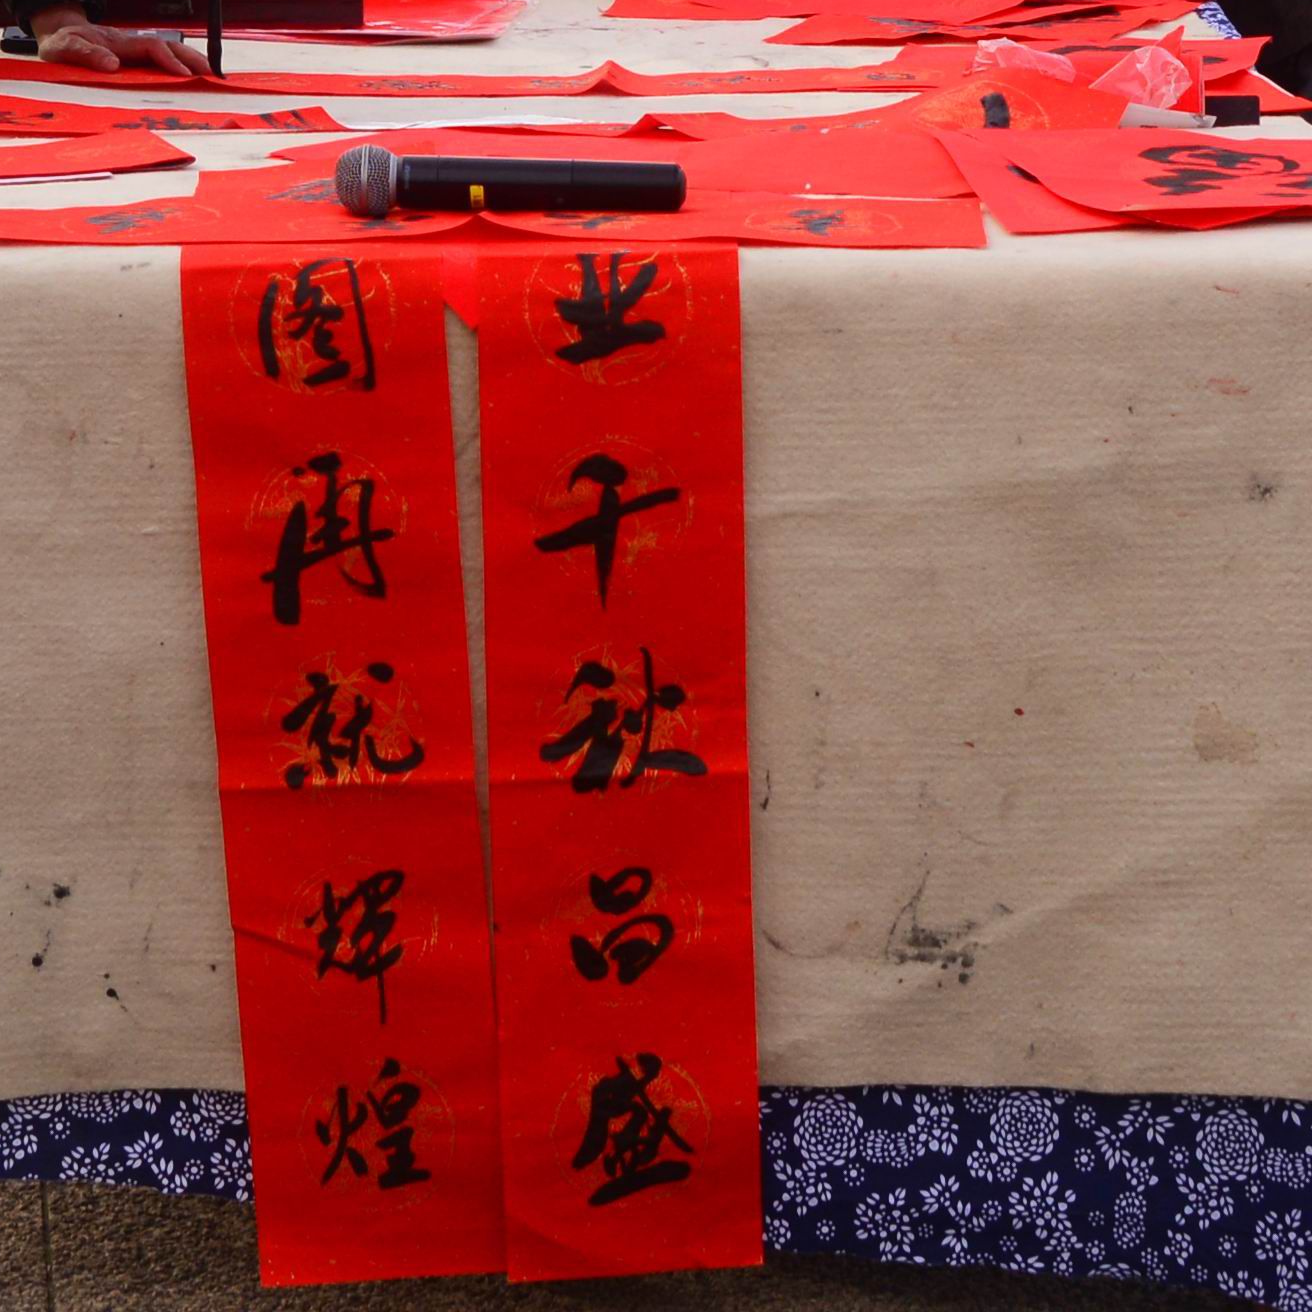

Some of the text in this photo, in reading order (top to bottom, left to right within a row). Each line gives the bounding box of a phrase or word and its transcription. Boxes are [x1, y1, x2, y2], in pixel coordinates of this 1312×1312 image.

[533, 253, 709, 1207] 业千秋昌盛
